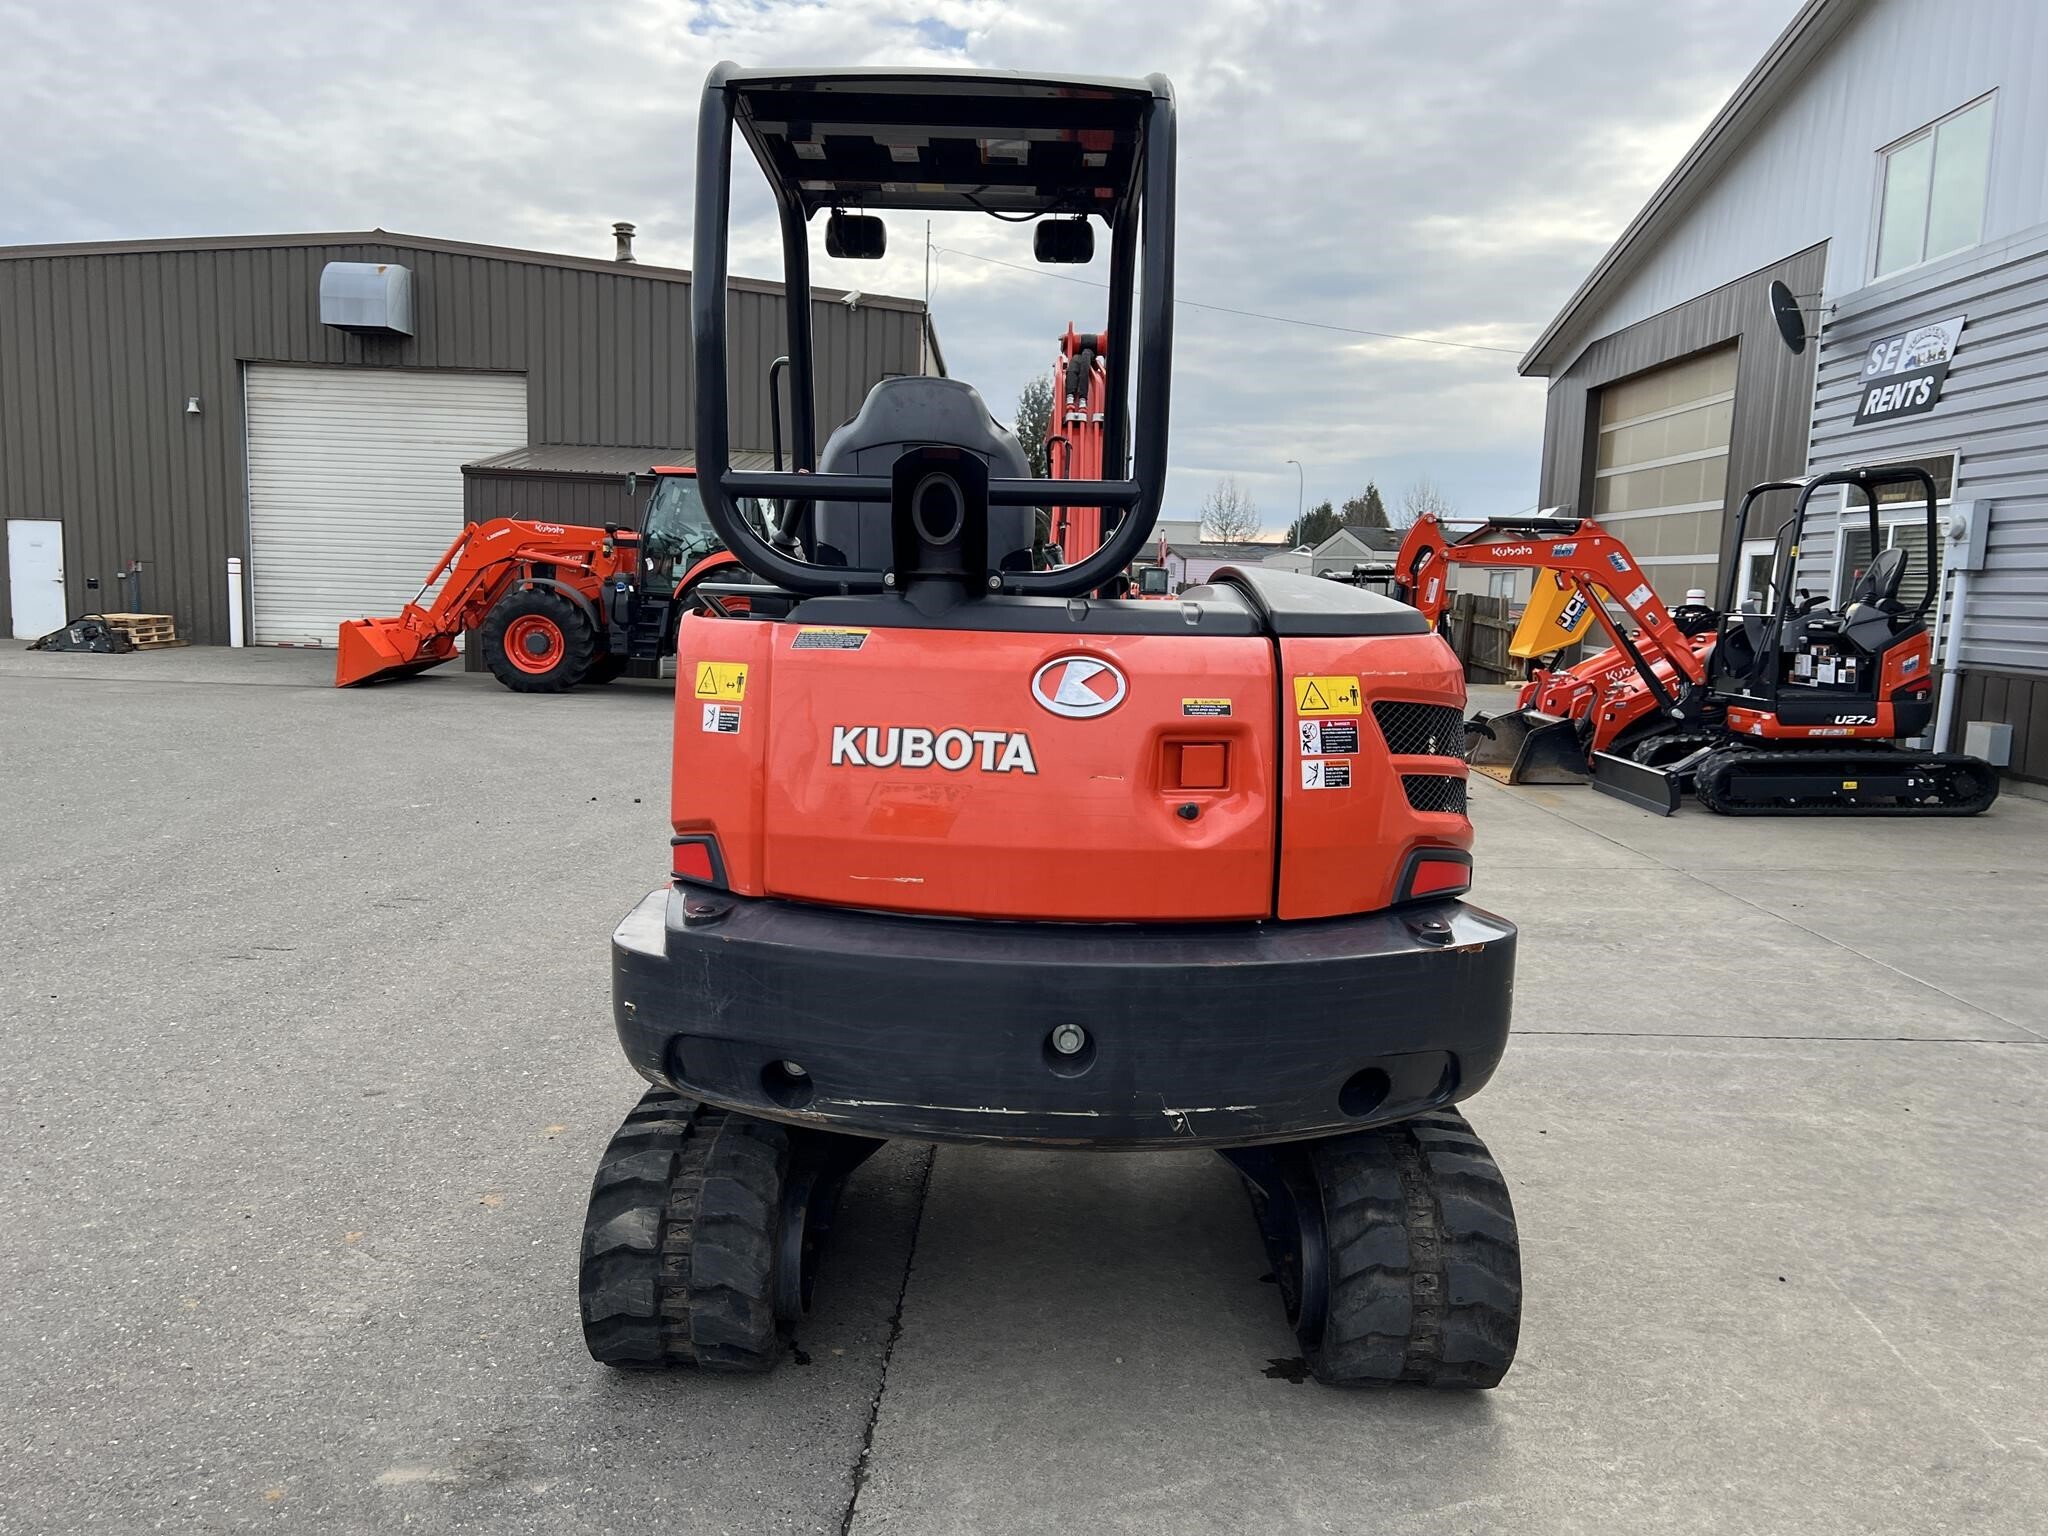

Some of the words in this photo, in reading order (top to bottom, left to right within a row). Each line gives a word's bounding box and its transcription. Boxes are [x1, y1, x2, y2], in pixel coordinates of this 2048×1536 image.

[1867, 339, 1903, 375] SE
[1862, 375, 1934, 417] RENTS
[534, 523, 565, 535] Kubota
[1492, 545, 1533, 557] Kubota
[1834, 715, 1876, 725] U27-4
[831, 726, 1038, 774] KUBOTA
